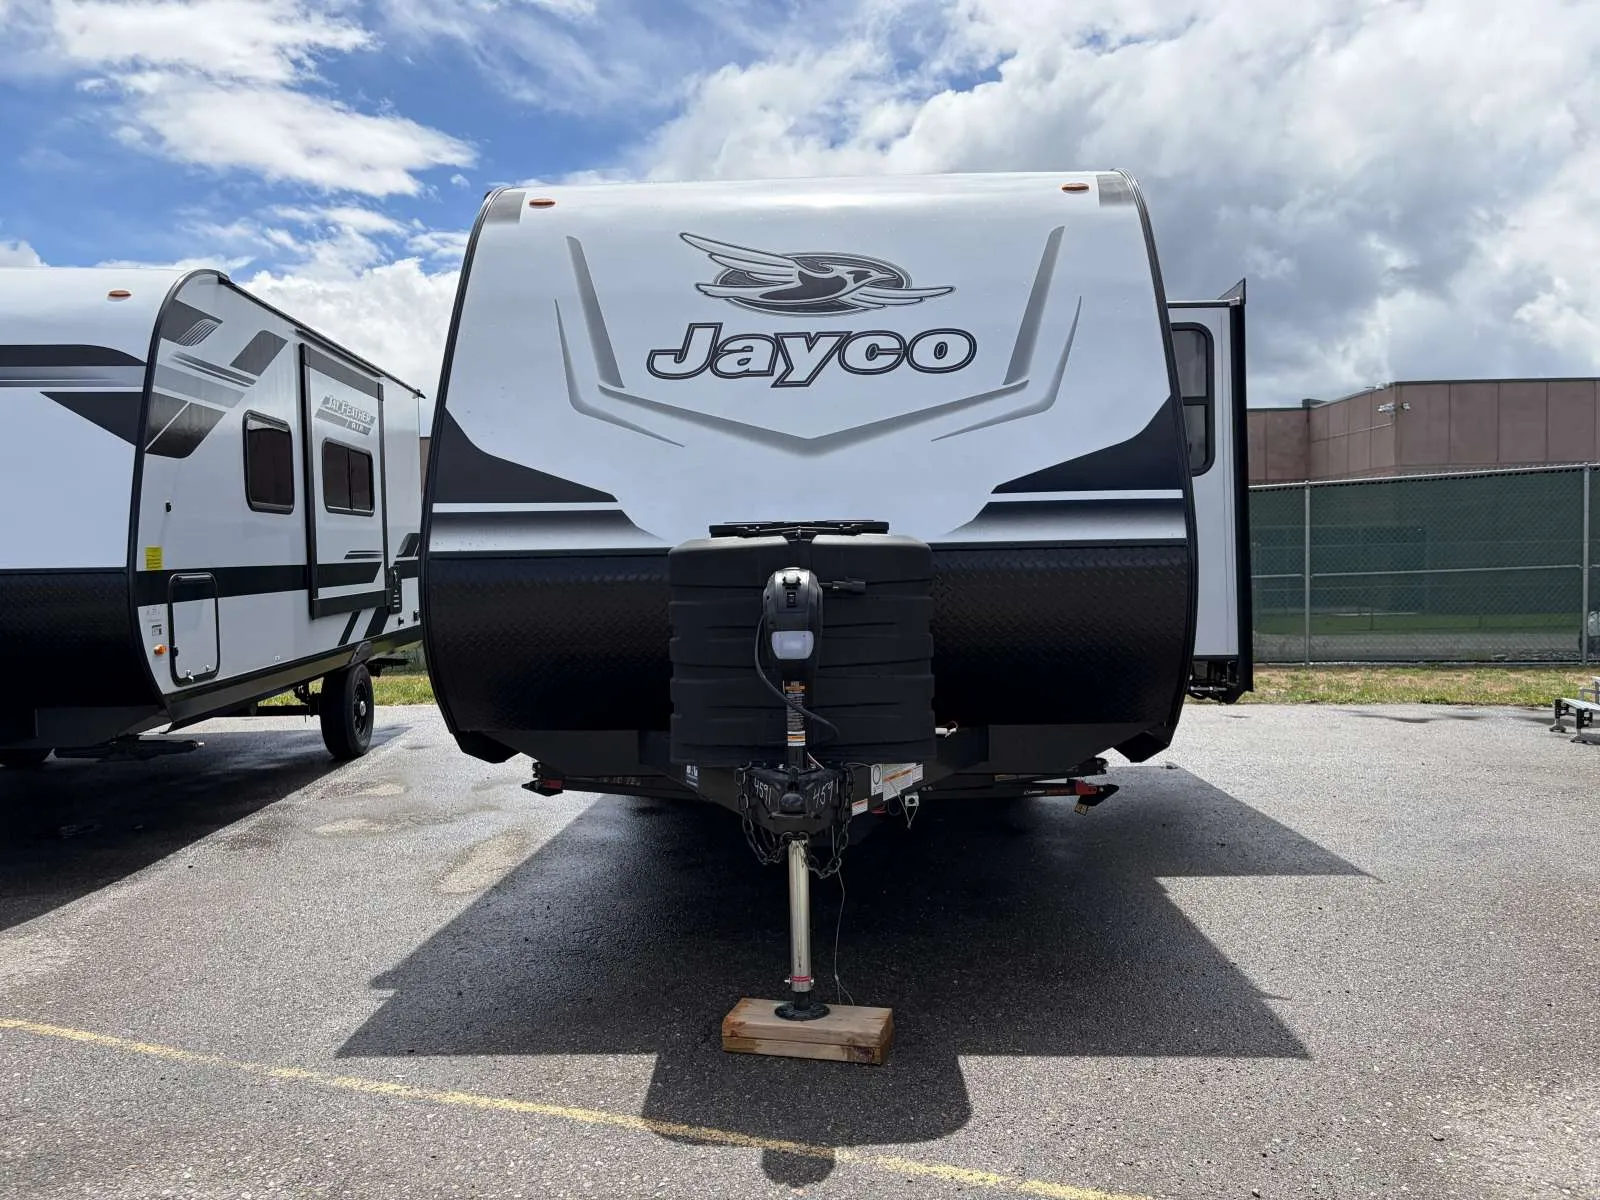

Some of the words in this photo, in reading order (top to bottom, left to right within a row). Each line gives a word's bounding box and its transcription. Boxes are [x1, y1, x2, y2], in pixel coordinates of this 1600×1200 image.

[646, 322, 977, 388] Jayco
[754, 777, 772, 806] 4591
[812, 776, 839, 808] 4591
